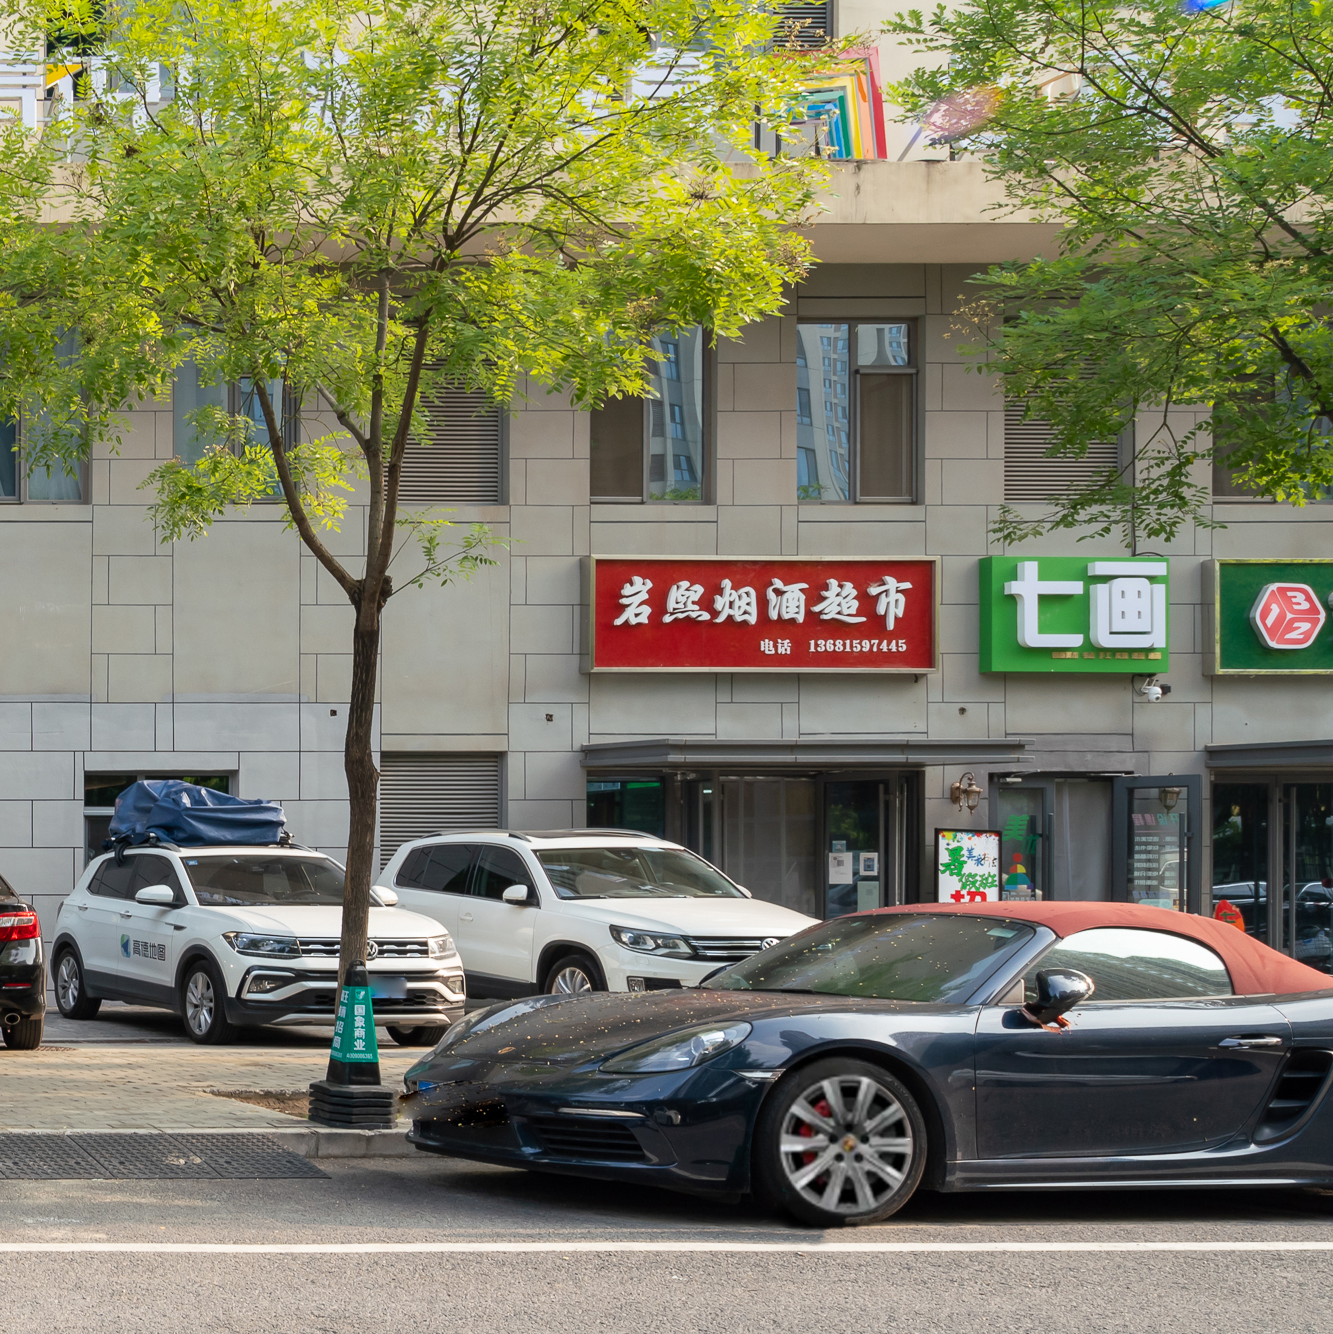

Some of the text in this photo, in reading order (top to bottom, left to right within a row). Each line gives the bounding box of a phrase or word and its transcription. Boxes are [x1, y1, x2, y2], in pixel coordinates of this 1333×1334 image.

[760, 638, 908, 655] 电话 13681597445
[132, 939, 166, 962] 高德地图
